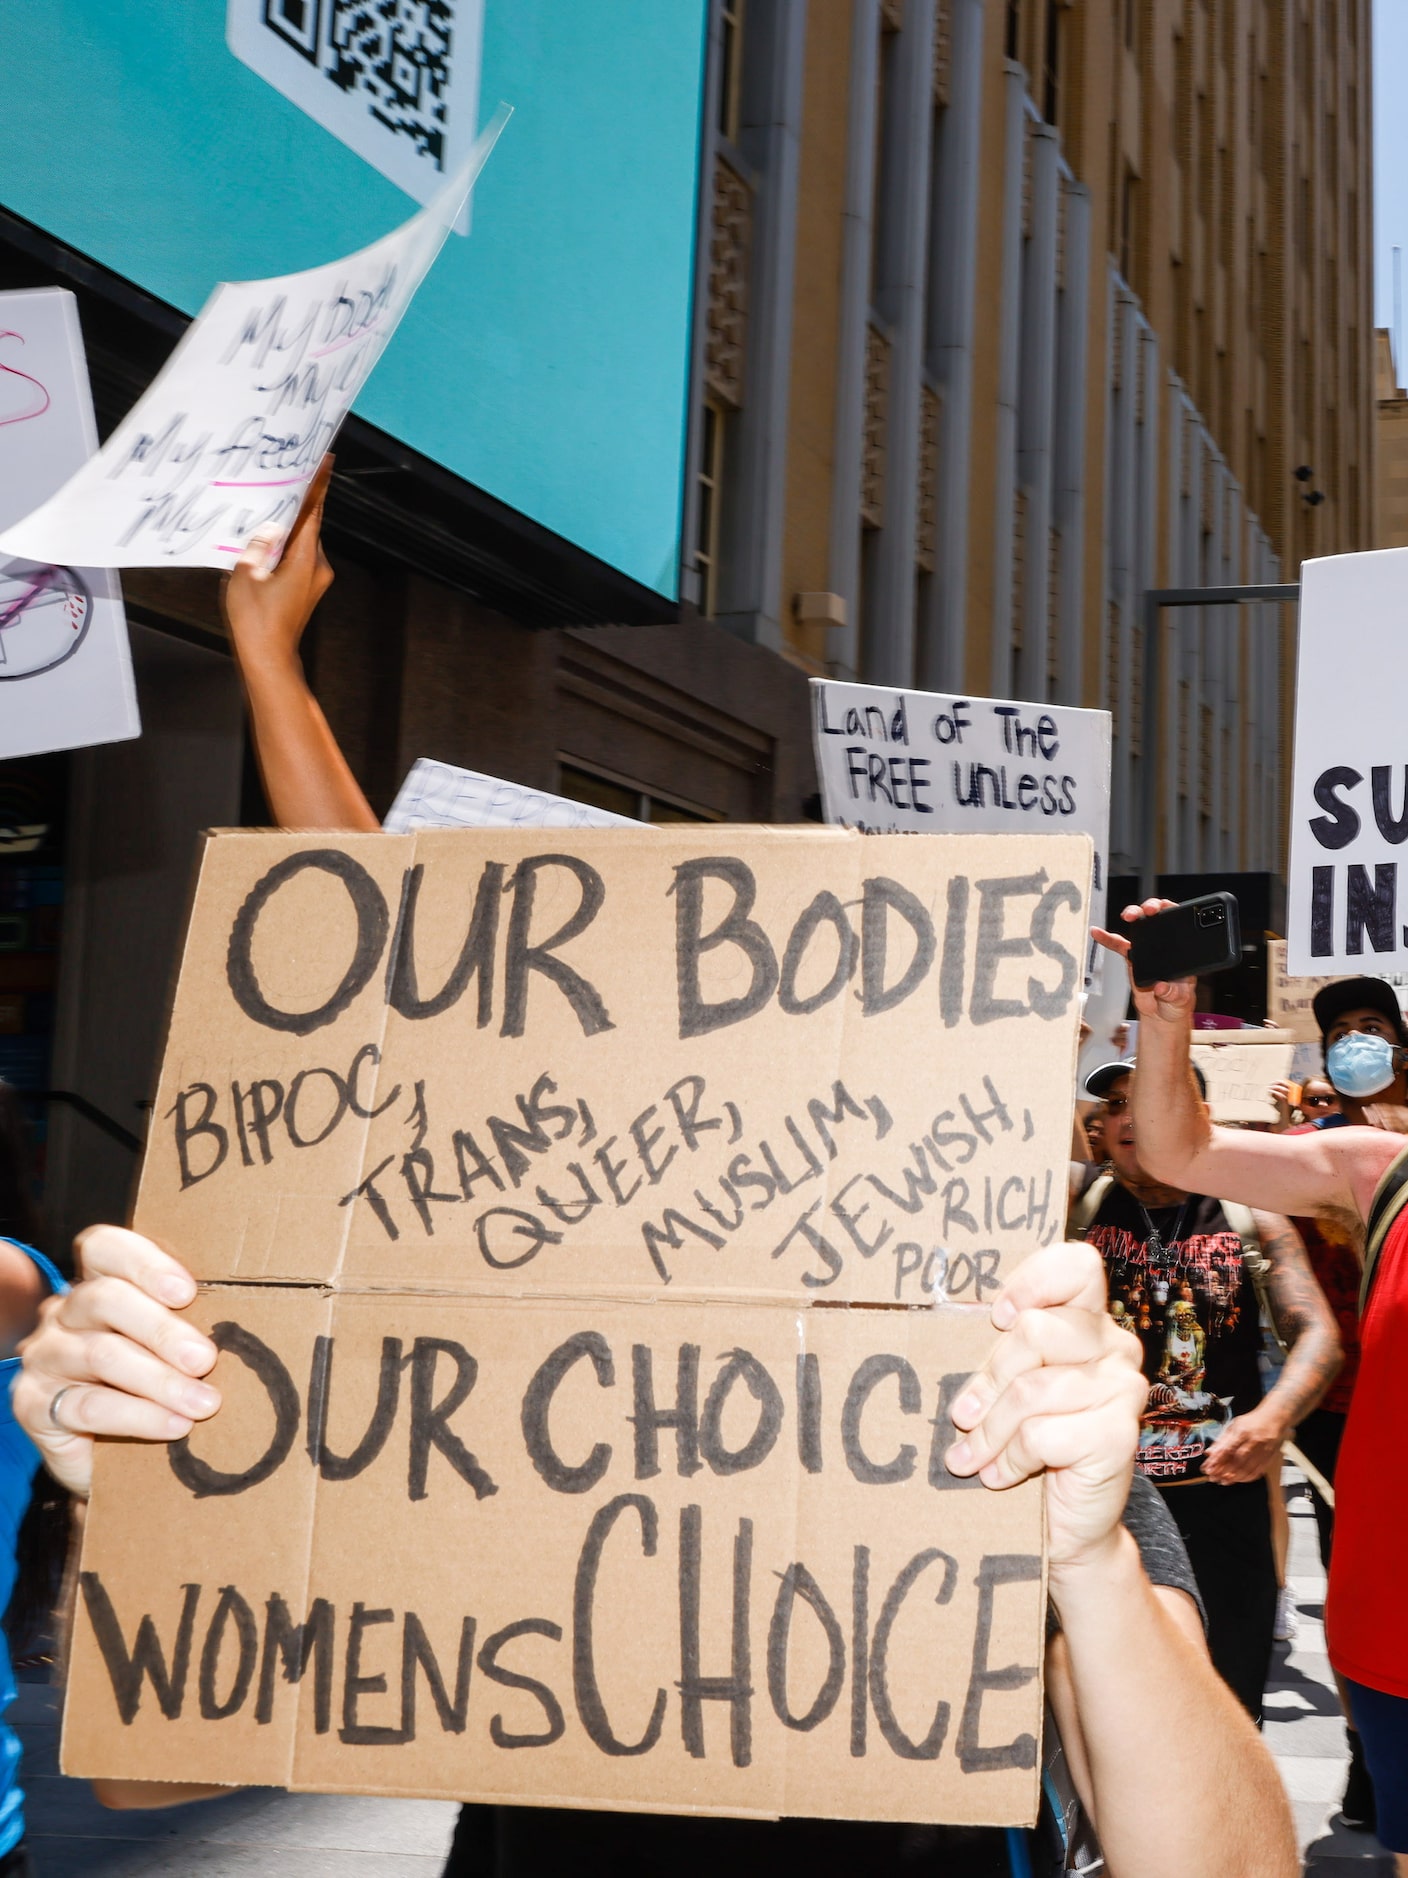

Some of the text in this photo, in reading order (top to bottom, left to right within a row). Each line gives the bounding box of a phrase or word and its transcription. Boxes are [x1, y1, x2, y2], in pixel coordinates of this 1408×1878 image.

[818, 684, 910, 746] Land
[993, 705, 1060, 762] The
[845, 746, 935, 813] FREE
[227, 848, 617, 1038] OUR
[666, 857, 1083, 1040] BODIES
[163, 1043, 1034, 1289] BIPOC, TRANS, QUEER, MUSLIM, JEWISH,
[941, 1169, 1058, 1247] RICH,
[892, 1241, 1002, 1301] POOR
[167, 1320, 500, 1502] OUR
[79, 1492, 1043, 1774] WOMENS CHOICE
